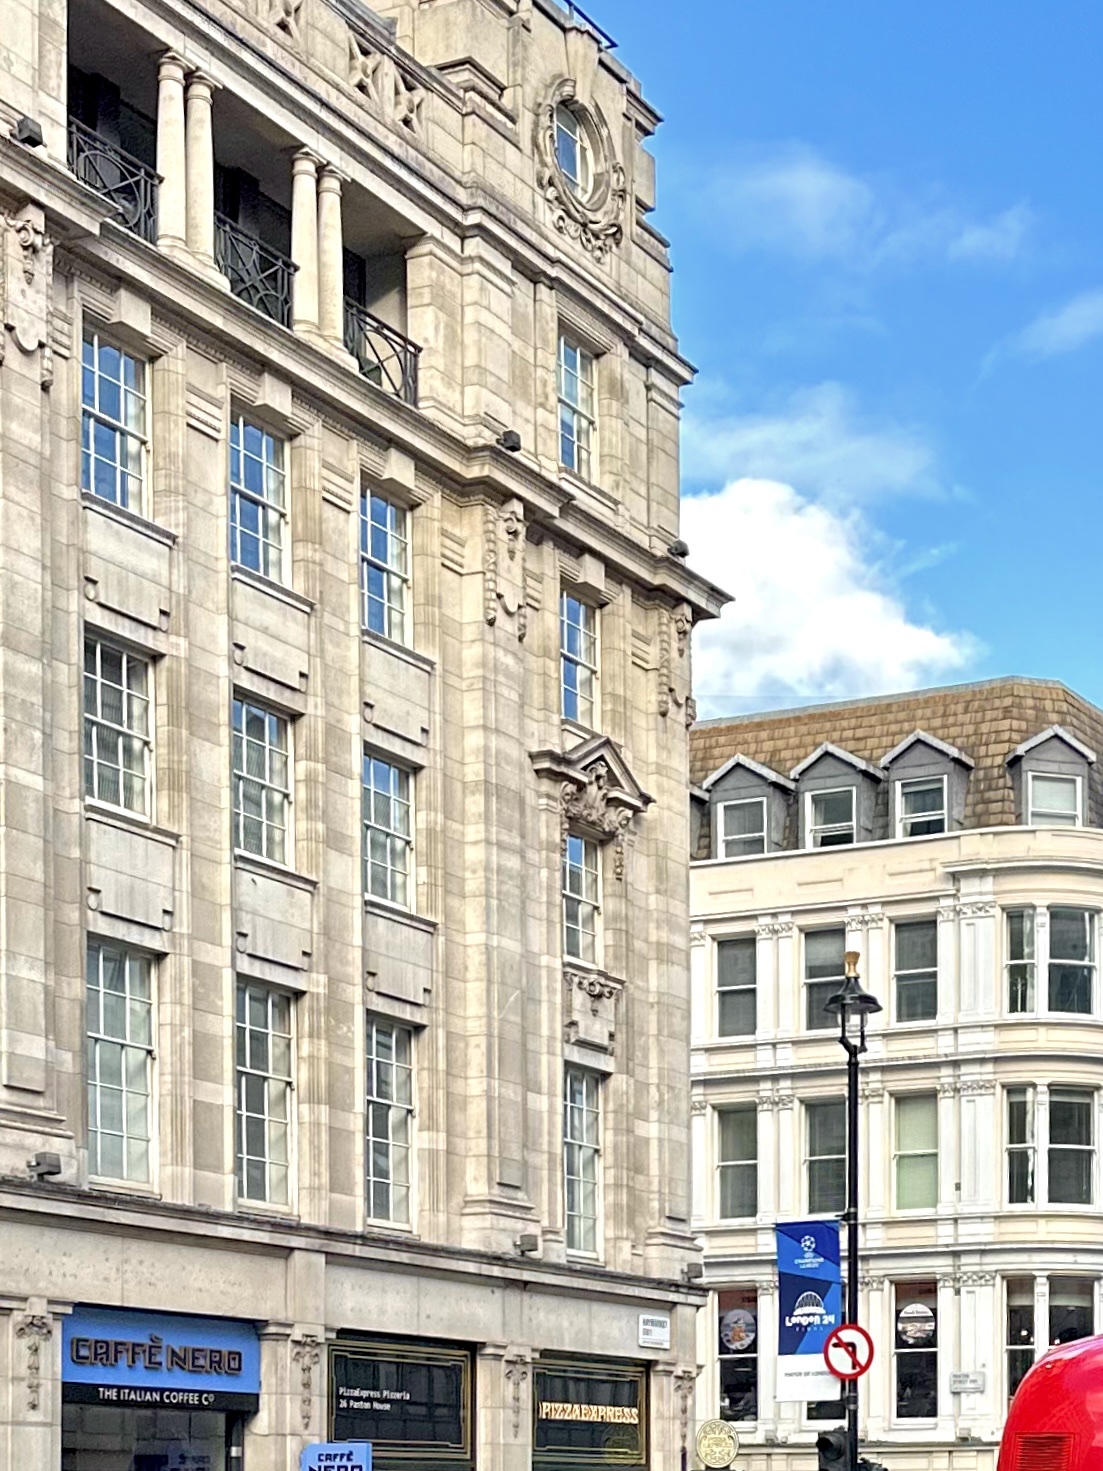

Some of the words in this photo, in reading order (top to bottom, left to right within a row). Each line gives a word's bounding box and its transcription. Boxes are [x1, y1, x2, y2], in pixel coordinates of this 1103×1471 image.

[822, 1314, 836, 1325] 24
[71, 1333, 163, 1369] CAFFÈ
[166, 1344, 243, 1377] NERO
[98, 1387, 118, 1400] THE
[120, 1388, 160, 1402] ITALIAN
[162, 1391, 199, 1405] COFFEE
